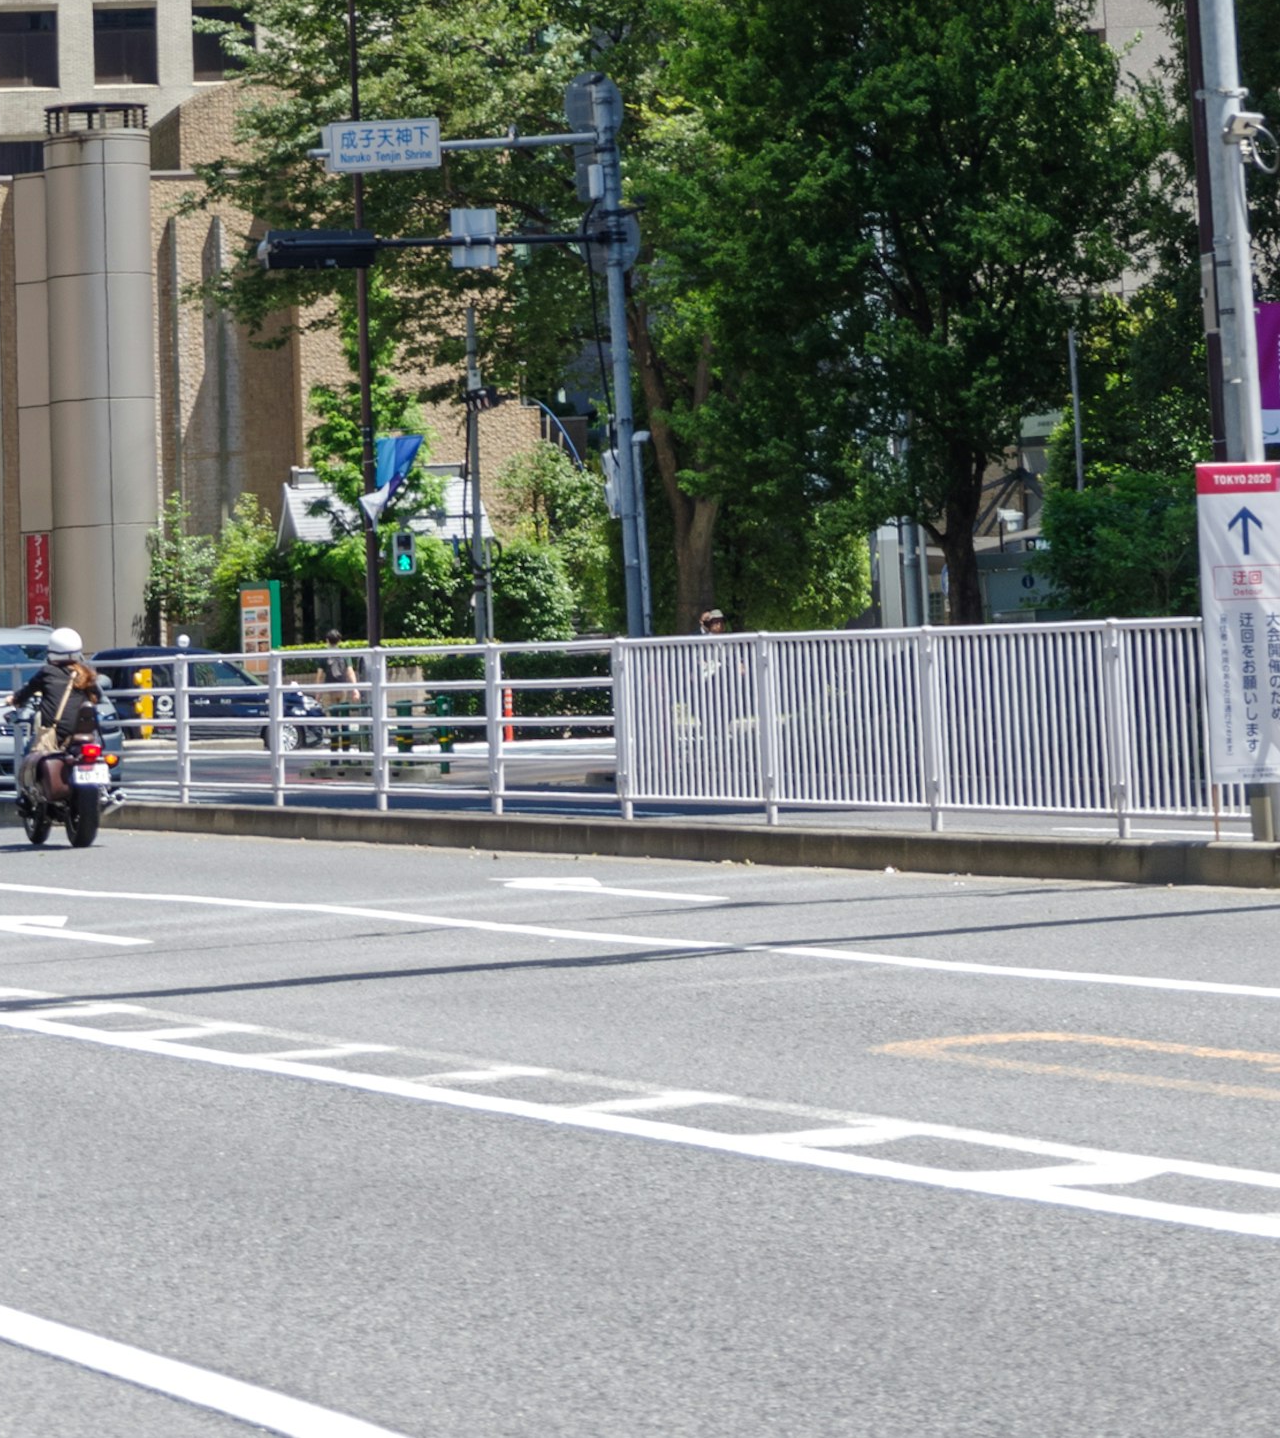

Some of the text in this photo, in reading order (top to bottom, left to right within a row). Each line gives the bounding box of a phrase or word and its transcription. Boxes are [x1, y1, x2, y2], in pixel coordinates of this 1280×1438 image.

[341, 125, 430, 149] 成子天神下
[340, 149, 432, 164] Naruko Tenjin Shrine
[1213, 473, 1272, 485] TOKYO 2020
[34, 534, 43, 581] ラーメン
[1232, 570, 1263, 586] 迂回
[1239, 612, 1260, 754] 迂回をお願いします
